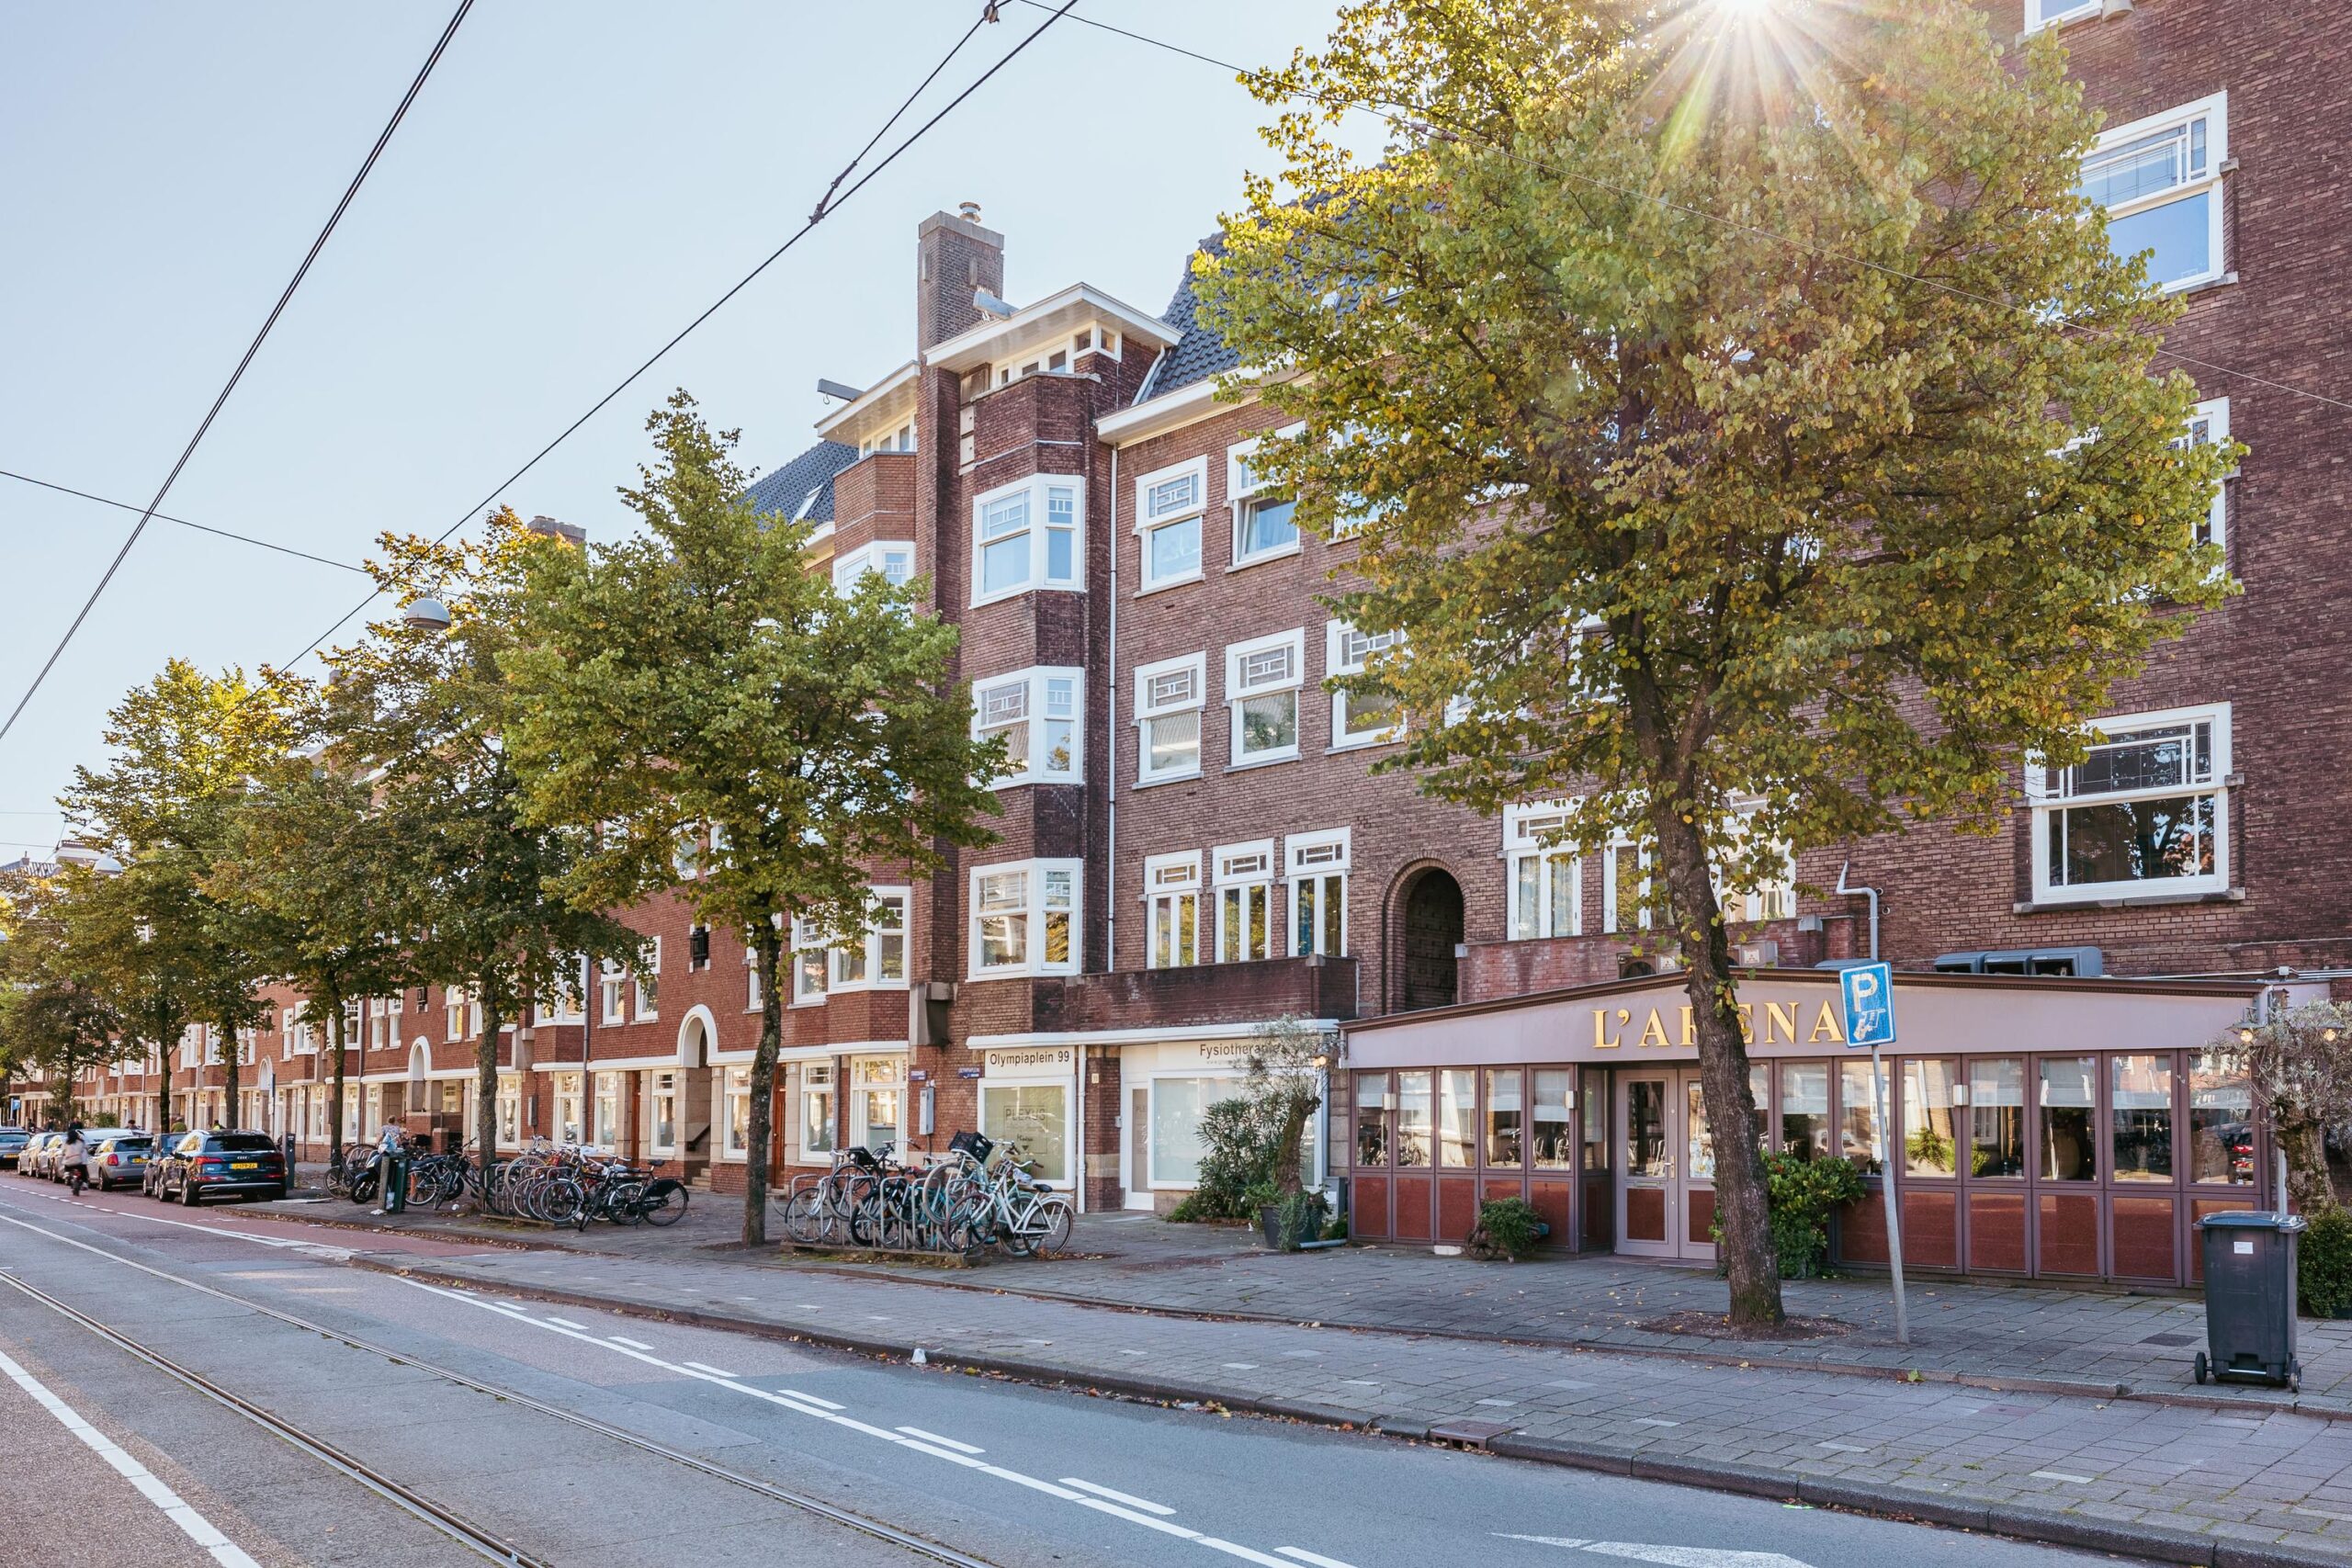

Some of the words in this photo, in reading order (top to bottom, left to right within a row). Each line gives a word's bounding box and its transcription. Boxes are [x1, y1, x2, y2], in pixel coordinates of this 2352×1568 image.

[1852, 974, 1877, 1012] P
[989, 1051, 1054, 1067] Olympiaplein
[1057, 1050, 1069, 1063] 99
[1006, 1108, 1046, 1121] PLEXUS
